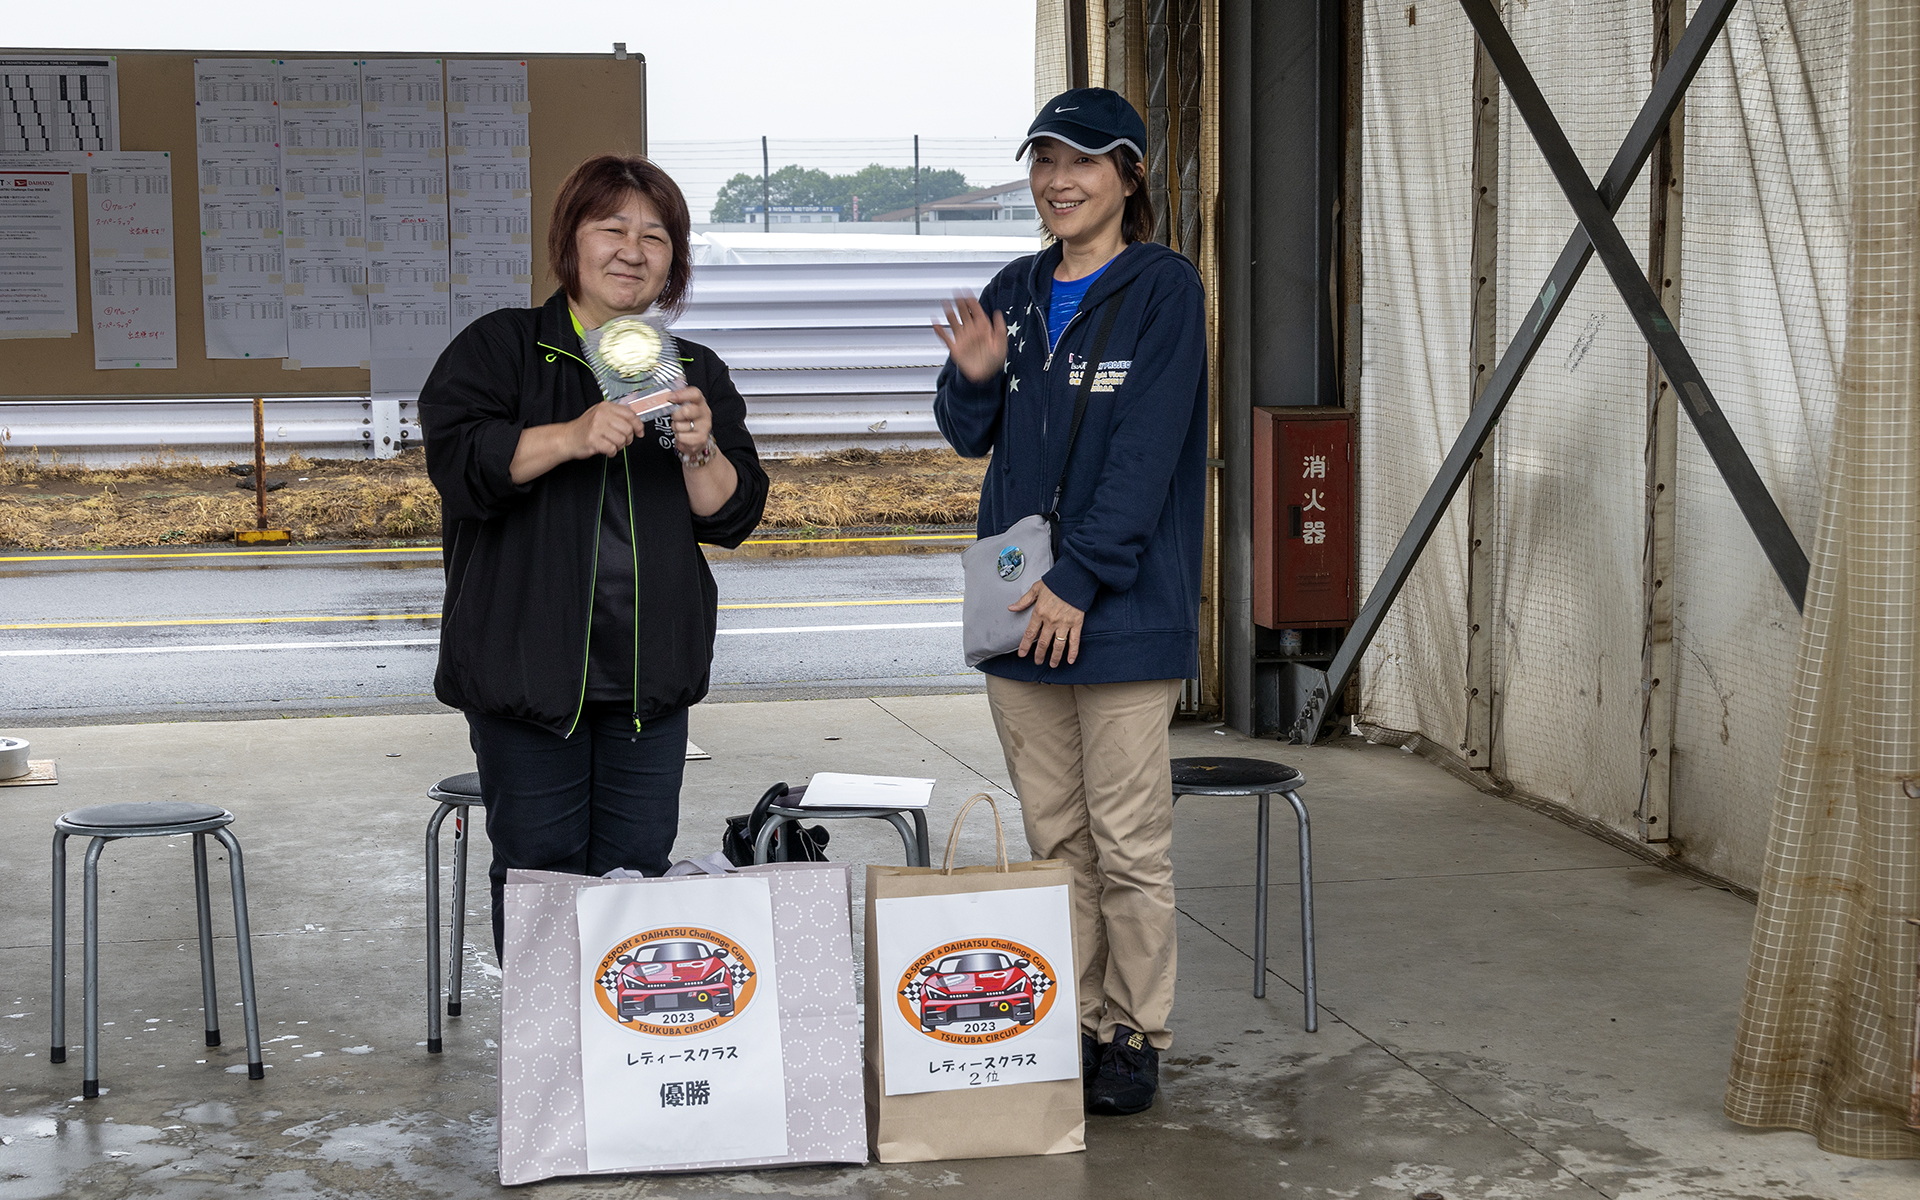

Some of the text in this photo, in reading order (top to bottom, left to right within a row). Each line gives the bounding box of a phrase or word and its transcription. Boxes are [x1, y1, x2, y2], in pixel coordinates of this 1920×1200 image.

[1302, 454, 1326, 545] 消火器
[602, 940, 633, 968] D-SPORT
[641, 929, 687, 942] DAIHATSU
[689, 929, 730, 949] Challenge
[731, 946, 745, 962] Cup
[905, 952, 936, 980] D-SPORT
[943, 940, 989, 953] DAIHATSU
[991, 940, 1031, 960] Challenge
[1032, 956, 1046, 971] Cup
[638, 1017, 719, 1035] TSUKUBA CIRCUIT
[662, 1012, 695, 1024] 2023
[964, 1021, 996, 1033] 2023
[940, 1026, 1019, 1044] TSUKUBA CIRCUIT
[627, 1046, 738, 1066] レディースクラス
[929, 1053, 1037, 1074] レディースクラス
[660, 1080, 711, 1108] 優勝
